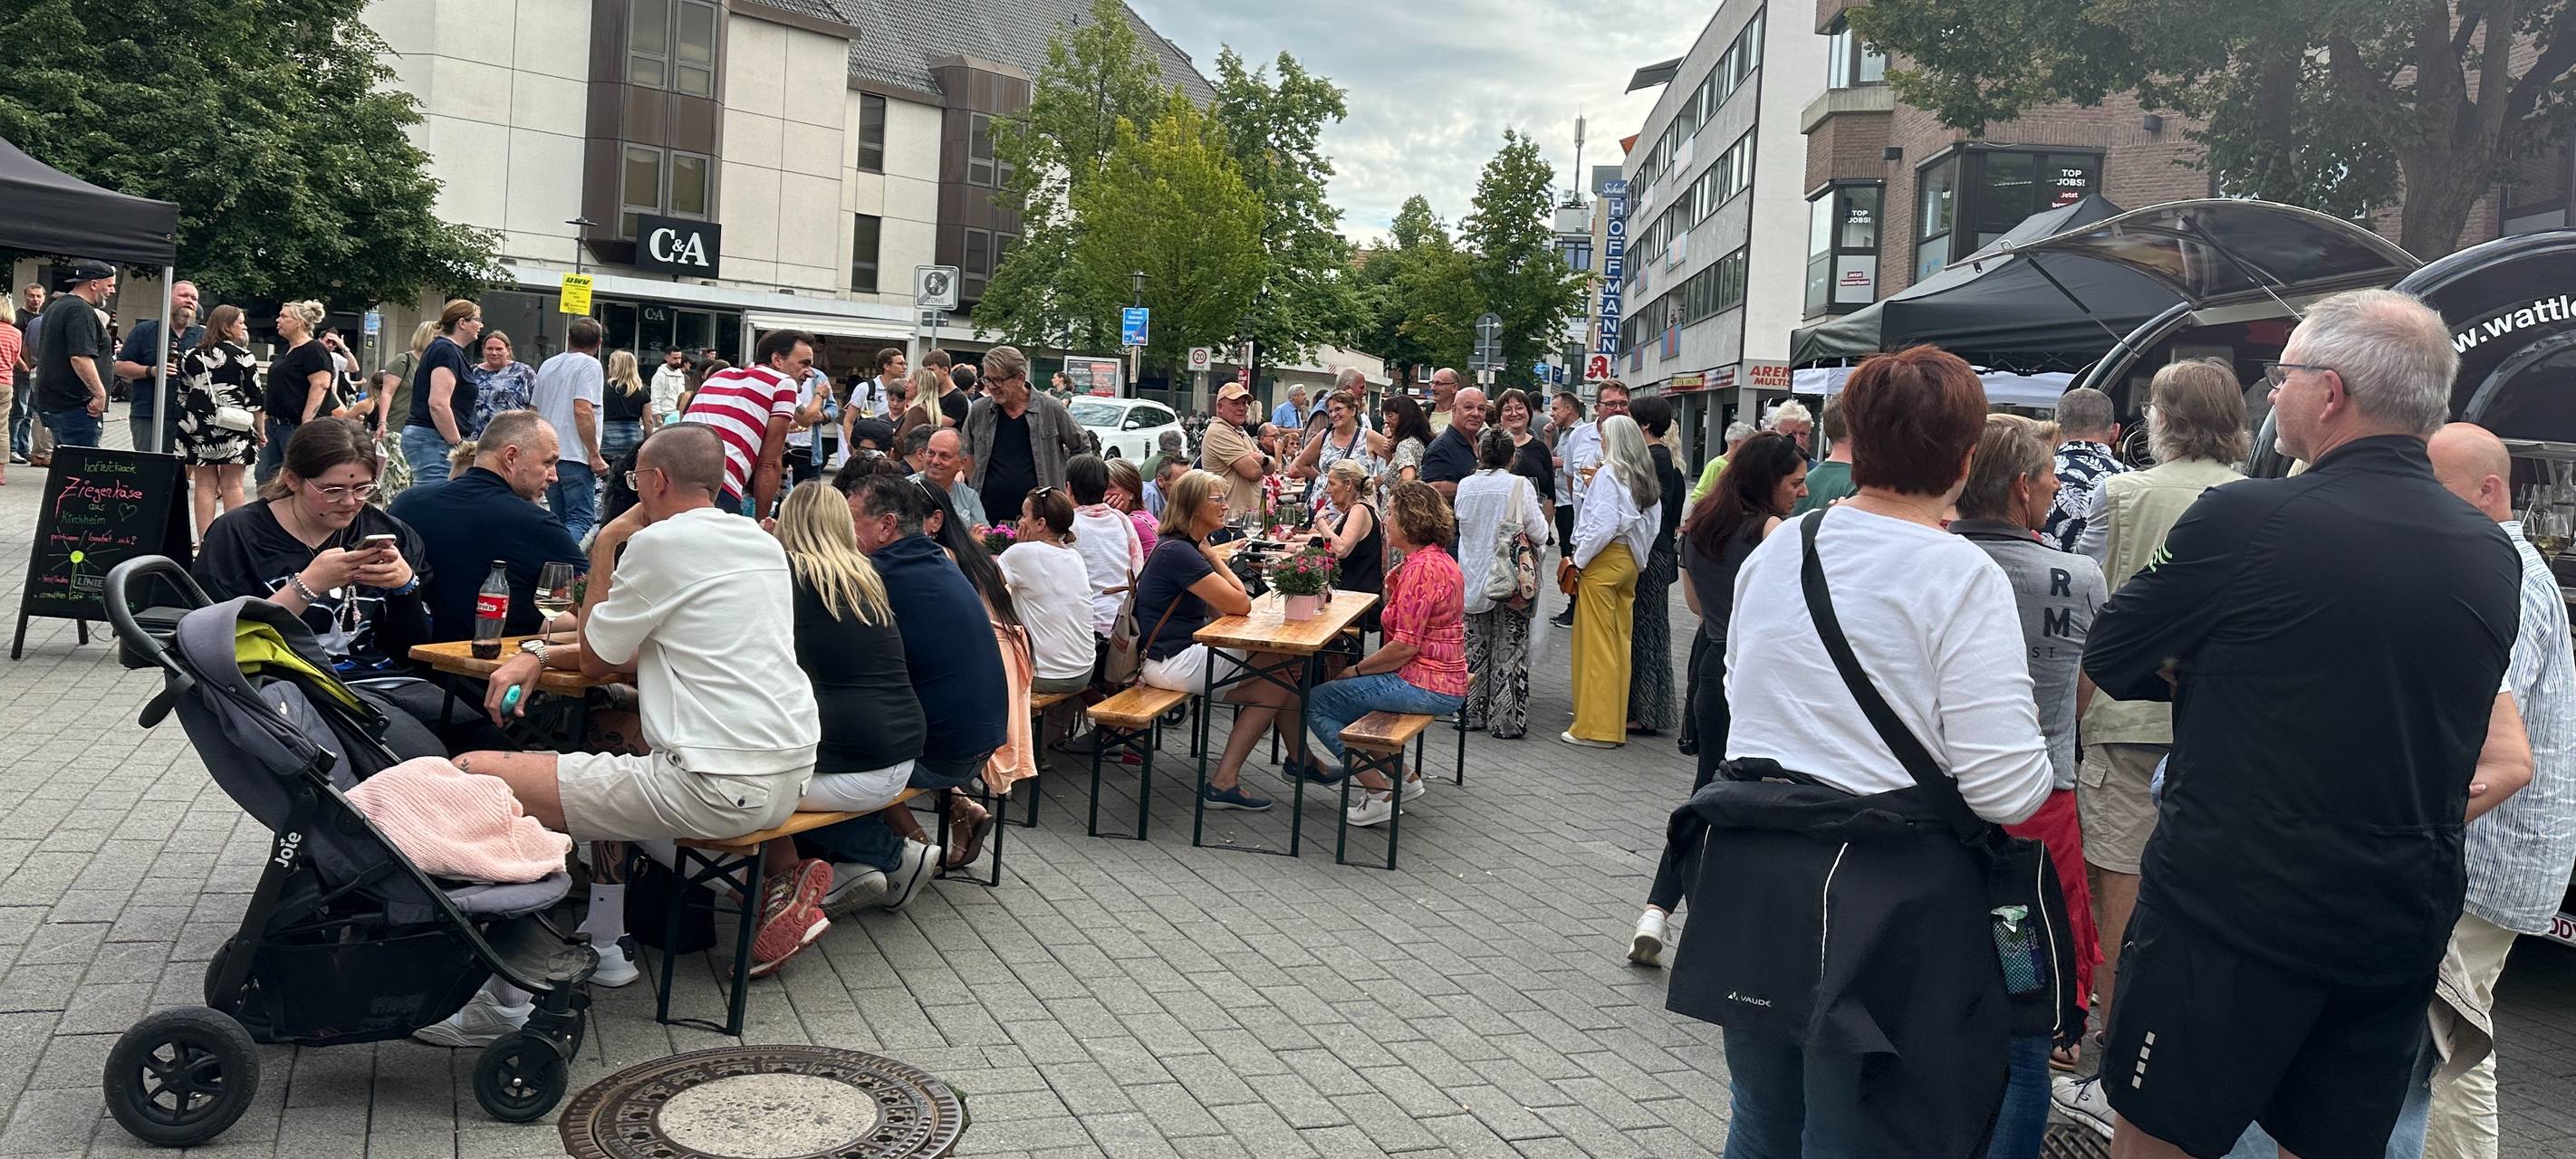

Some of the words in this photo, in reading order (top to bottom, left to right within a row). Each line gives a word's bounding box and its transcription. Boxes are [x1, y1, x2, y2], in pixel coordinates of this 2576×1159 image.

[2056, 178, 2086, 187] JOBS!
[2062, 169, 2082, 177] TOP
[1603, 183, 1627, 195] Schuh
[649, 228, 709, 267] C&A
[1602, 202, 1624, 352] HOFFMANN
[2451, 294, 2576, 354] w.wattl
[274, 832, 302, 868] Joie
[1740, 994, 1772, 1007] VAUDE
